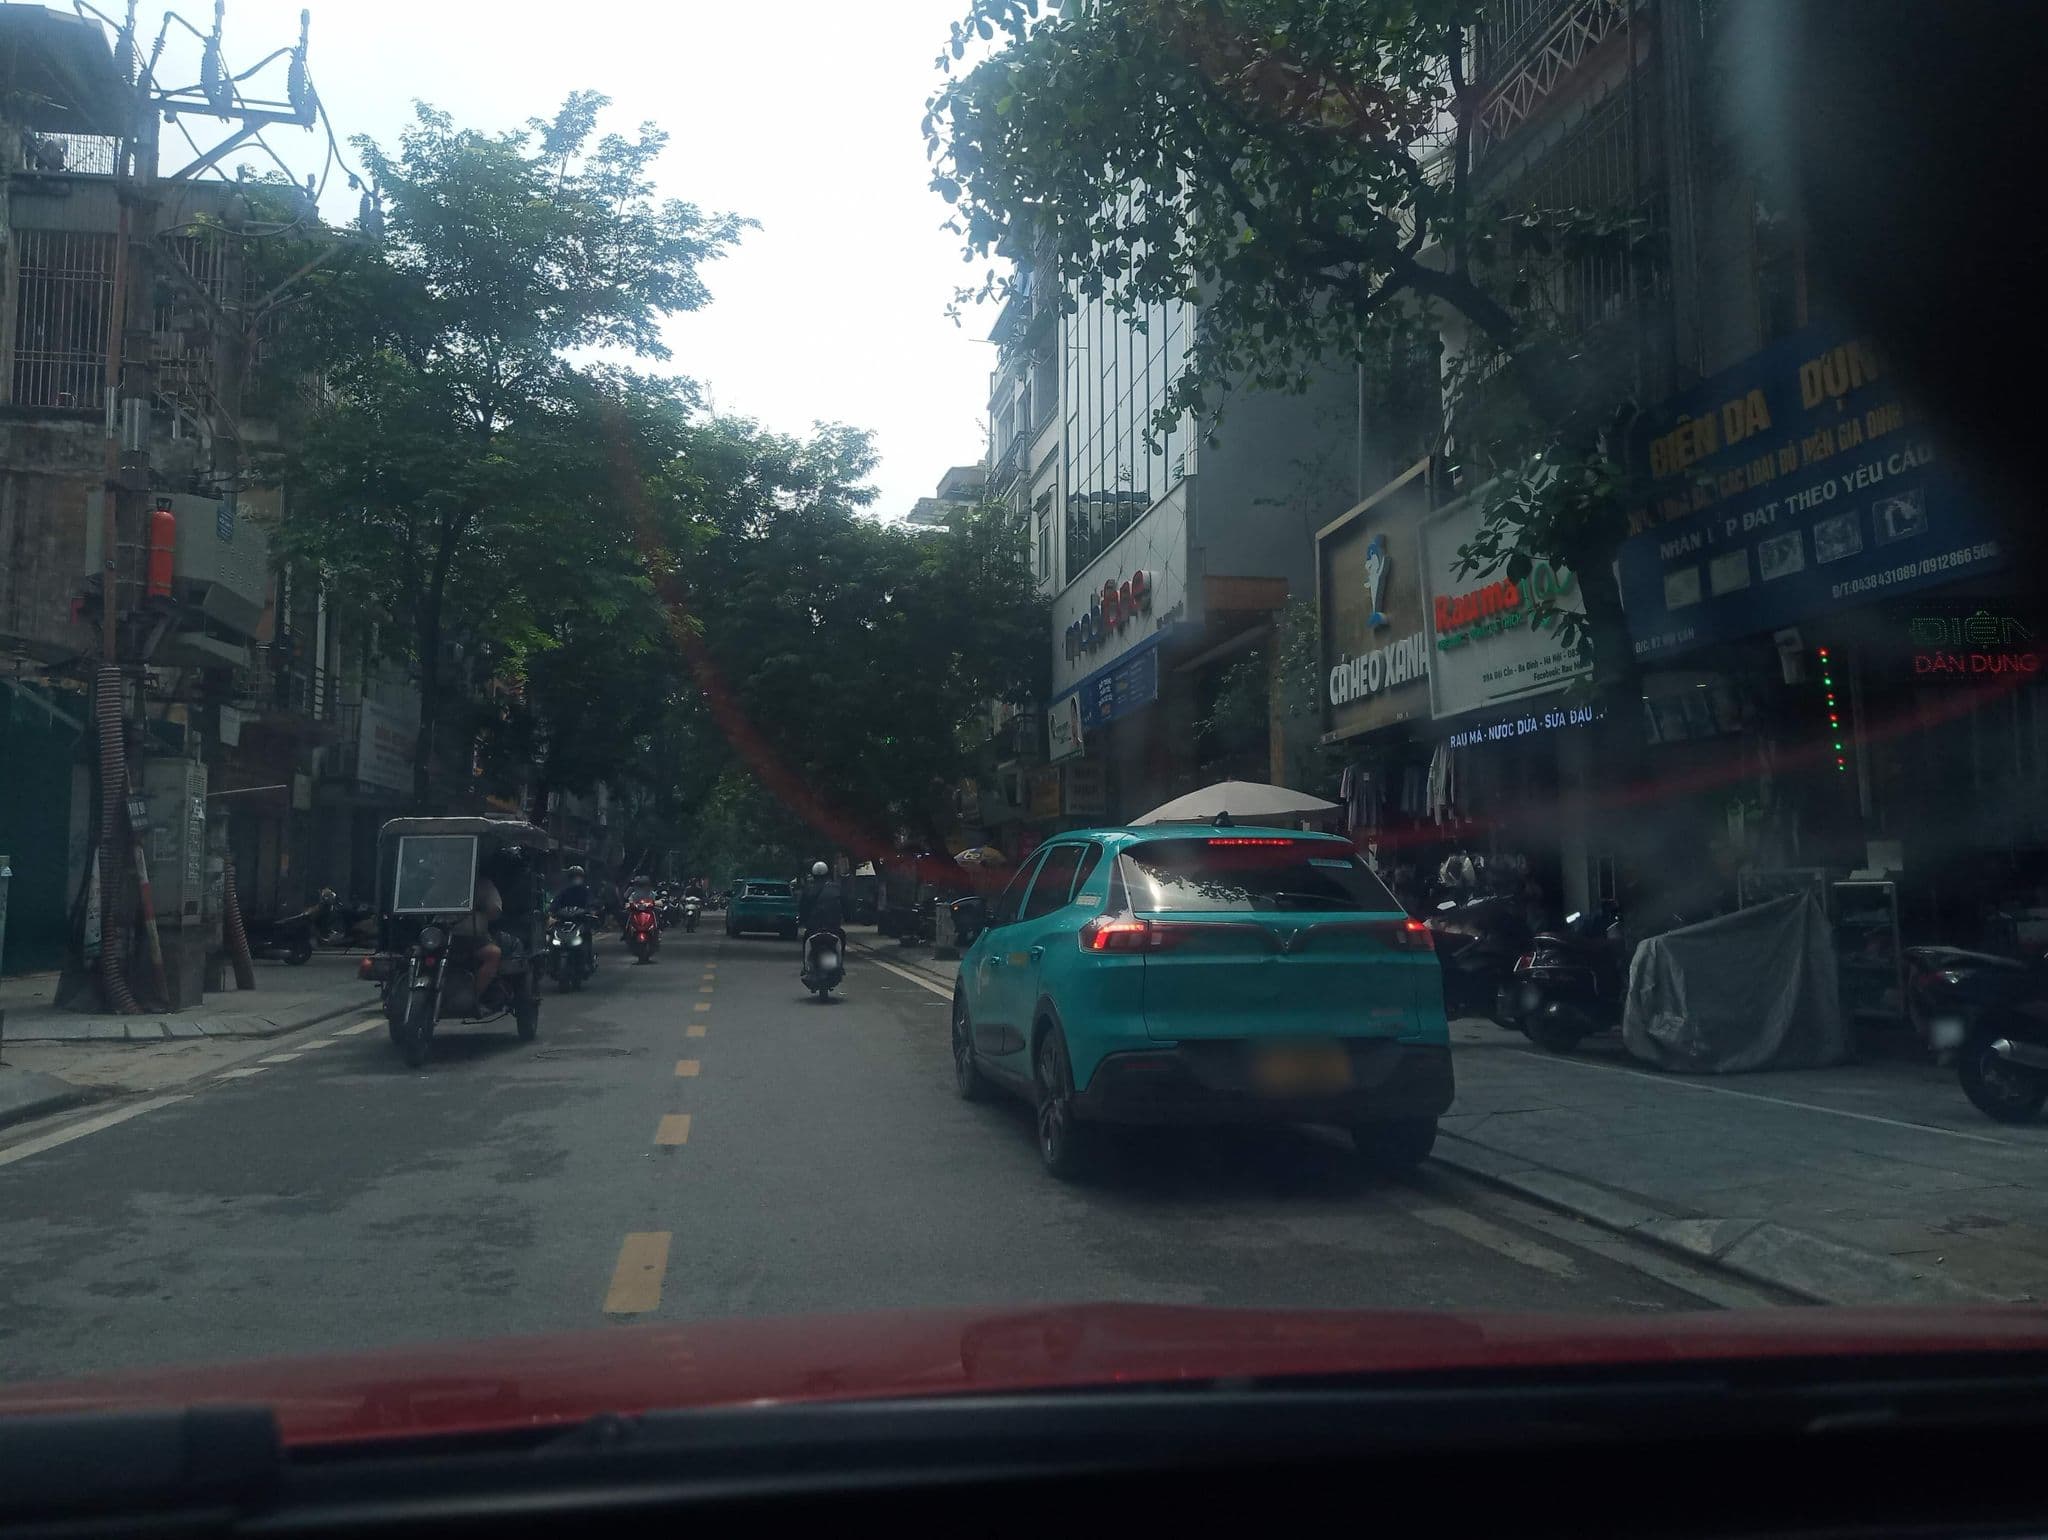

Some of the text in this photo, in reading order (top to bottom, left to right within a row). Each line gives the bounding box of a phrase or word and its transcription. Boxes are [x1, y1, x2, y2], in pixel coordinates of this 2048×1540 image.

[1783, 478, 1837, 516] THEO
[1840, 459, 1884, 496] YÊU
[1329, 653, 1351, 706] CÁ
[1350, 649, 1381, 700] HEO
[1382, 631, 1429, 688] XANH
[1449, 731, 1468, 750] RAU
[1469, 723, 1483, 746] MÁ
[1488, 718, 1514, 742] NƯỚC
[1544, 706, 1566, 730] SỮA
